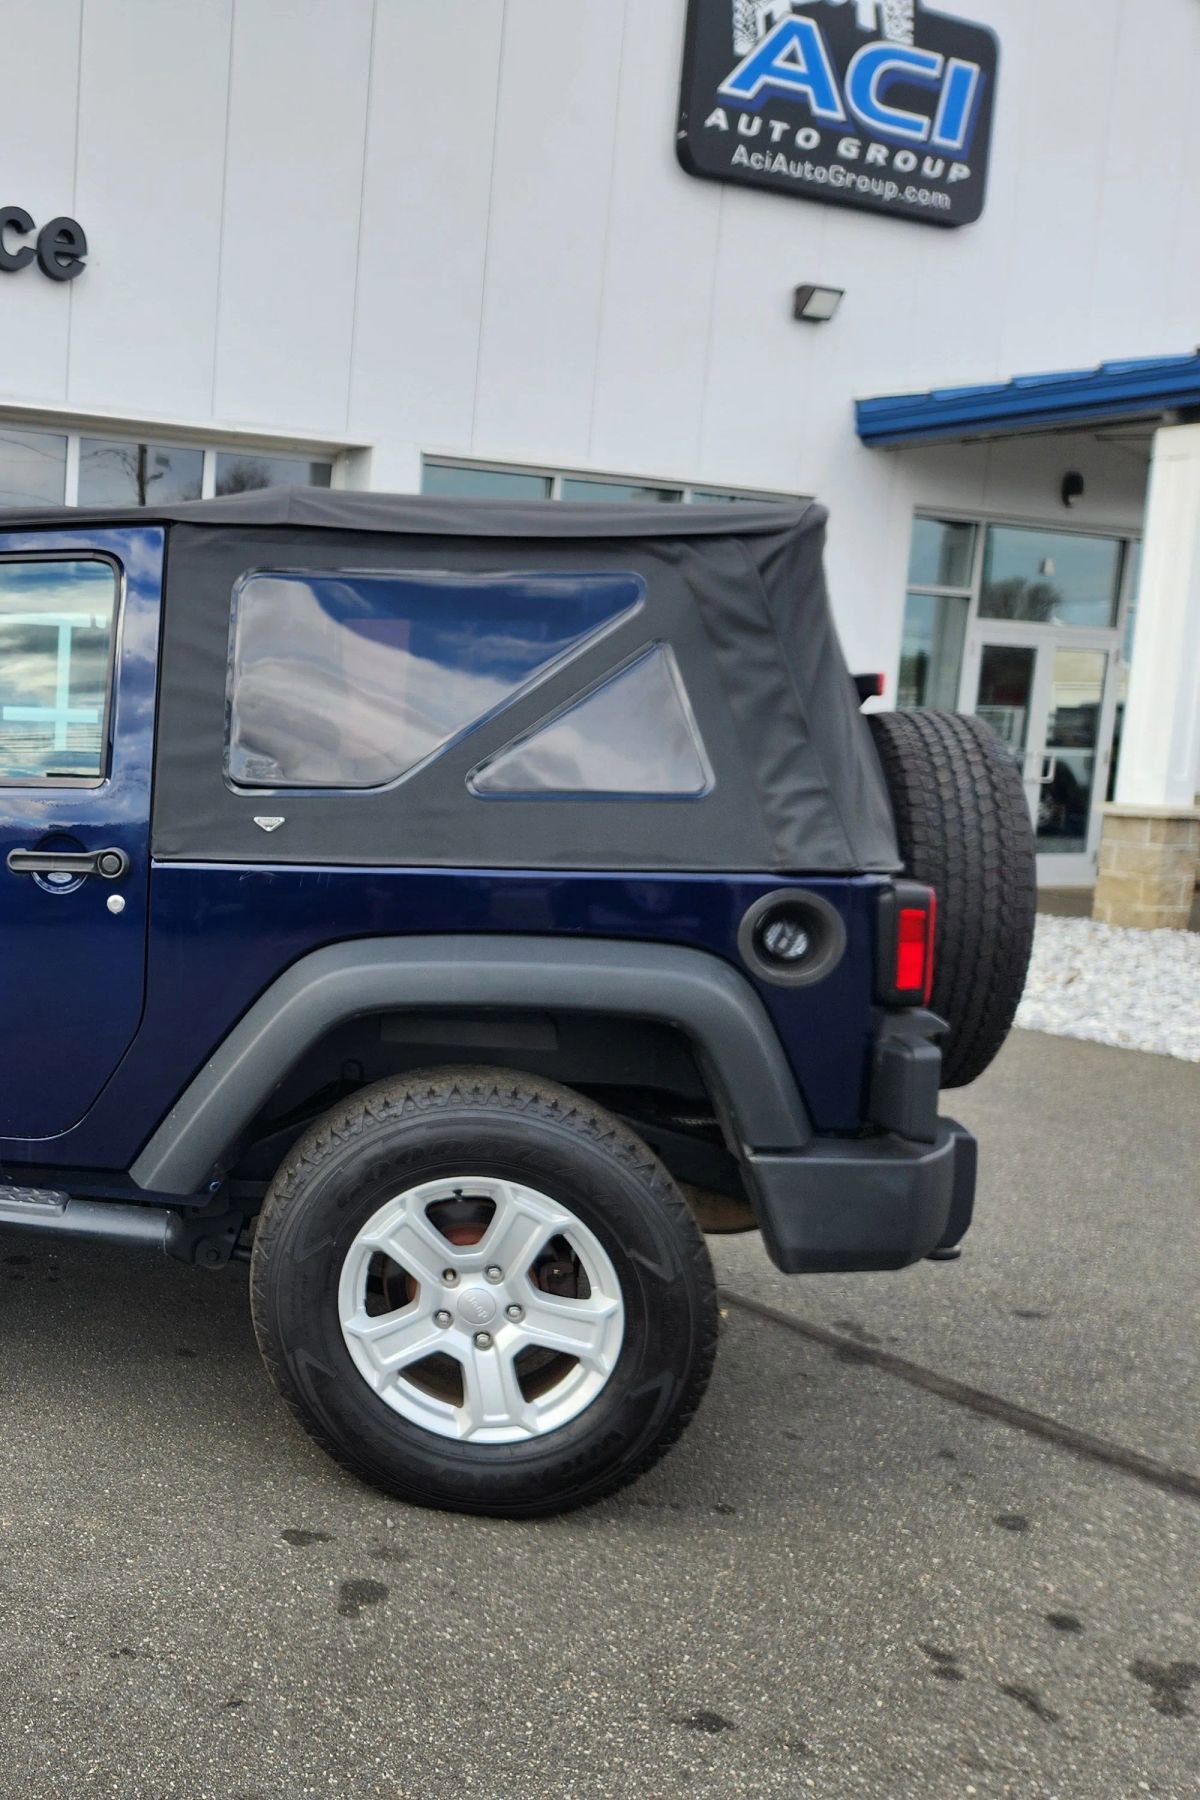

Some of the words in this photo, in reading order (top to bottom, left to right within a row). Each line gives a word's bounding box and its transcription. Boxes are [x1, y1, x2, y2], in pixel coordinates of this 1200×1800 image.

[717, 13, 982, 151] ACI
[704, 107, 821, 150] AUTO
[837, 136, 972, 184] GROUP
[731, 144, 951, 210] AciAutoGroup.com
